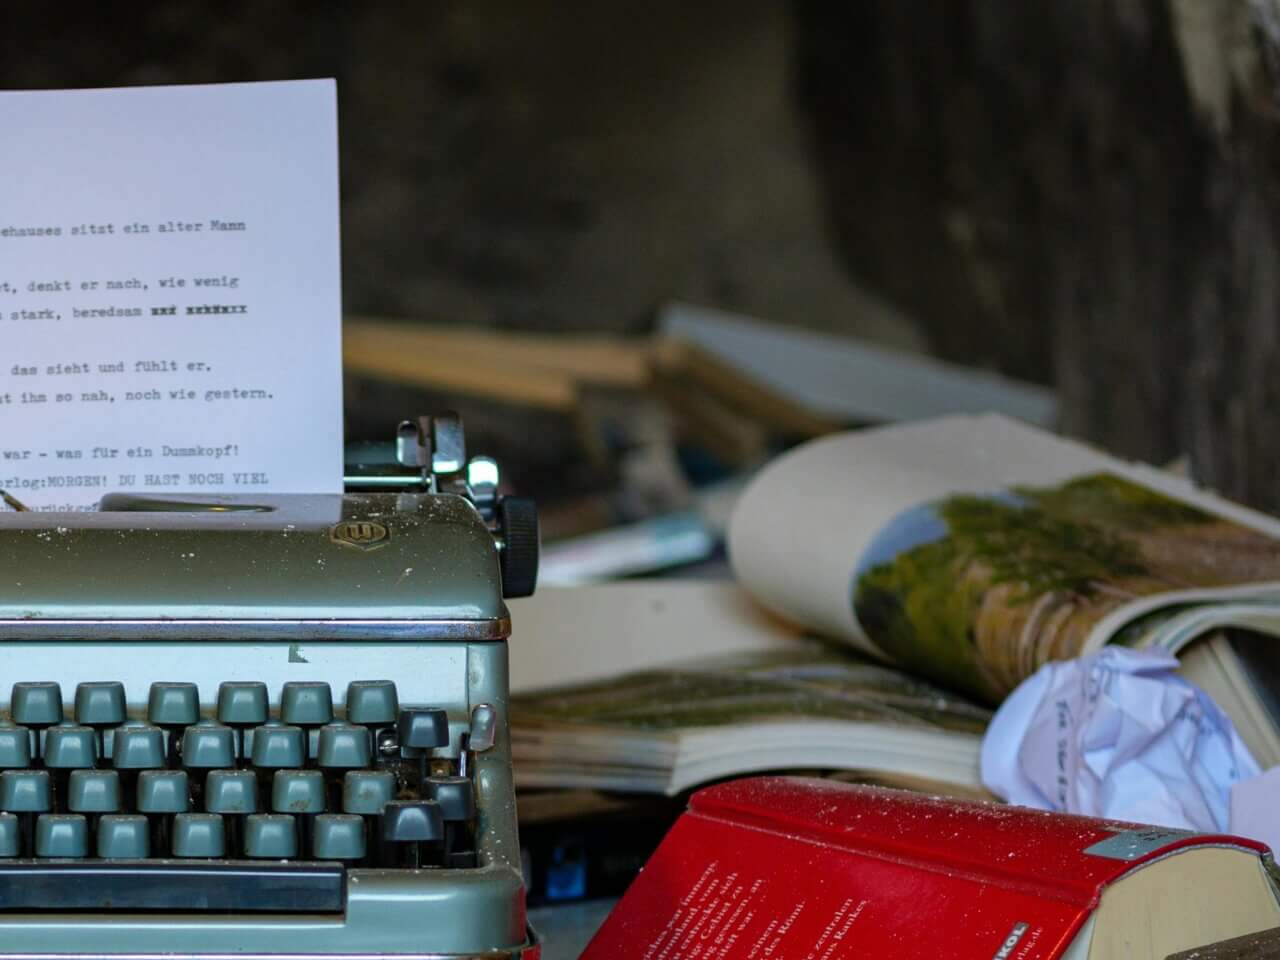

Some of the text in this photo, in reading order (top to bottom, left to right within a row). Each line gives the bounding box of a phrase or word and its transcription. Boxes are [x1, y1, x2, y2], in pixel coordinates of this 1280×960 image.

[70, 224, 115, 235] sitzt
[122, 222, 151, 234] ein
[157, 221, 204, 232] alter
[209, 220, 247, 231] Mann
[27, 281, 72, 292] denkt
[80, 281, 99, 290] er
[105, 278, 149, 291] nach,
[158, 277, 187, 288] wie
[193, 275, 239, 289] wenig
[10, 308, 62, 320] stark,
[72, 306, 143, 318] beredsam
[10, 364, 39, 376] das
[45, 363, 91, 375] sieht
[97, 361, 125, 373] und
[134, 360, 179, 372] fühlt
[185, 362, 212, 372] er.
[20, 392, 48, 404] ihm
[55, 393, 74, 402] so
[80, 390, 116, 403] nah,
[124, 389, 162, 400] noch
[168, 389, 197, 400] wie
[203, 388, 274, 402] gestern.
[2, 451, 31, 460] war
[55, 450, 83, 459] was
[92, 447, 119, 459] für
[126, 446, 153, 458] ein
[161, 443, 239, 460] Dummkopf!
[118, 474, 136, 487] DU
[144, 473, 181, 487] HAST
[188, 473, 225, 486] NOCH
[233, 472, 269, 485] VIEL
[698, 878, 719, 902] vom
[666, 908, 683, 929] war
[680, 897, 720, 950] erstreckte
[719, 872, 738, 895] sich
[699, 901, 732, 940] Gebiet
[731, 885, 743, 900] zu
[714, 895, 752, 945] gewesen,
[750, 879, 764, 893] an
[736, 909, 756, 931] war.
[832, 899, 868, 940] Rankes
[763, 937, 781, 956] des
[776, 900, 805, 934] Römi-
[813, 898, 853, 951] zentralen
[747, 919, 778, 959] seinem
